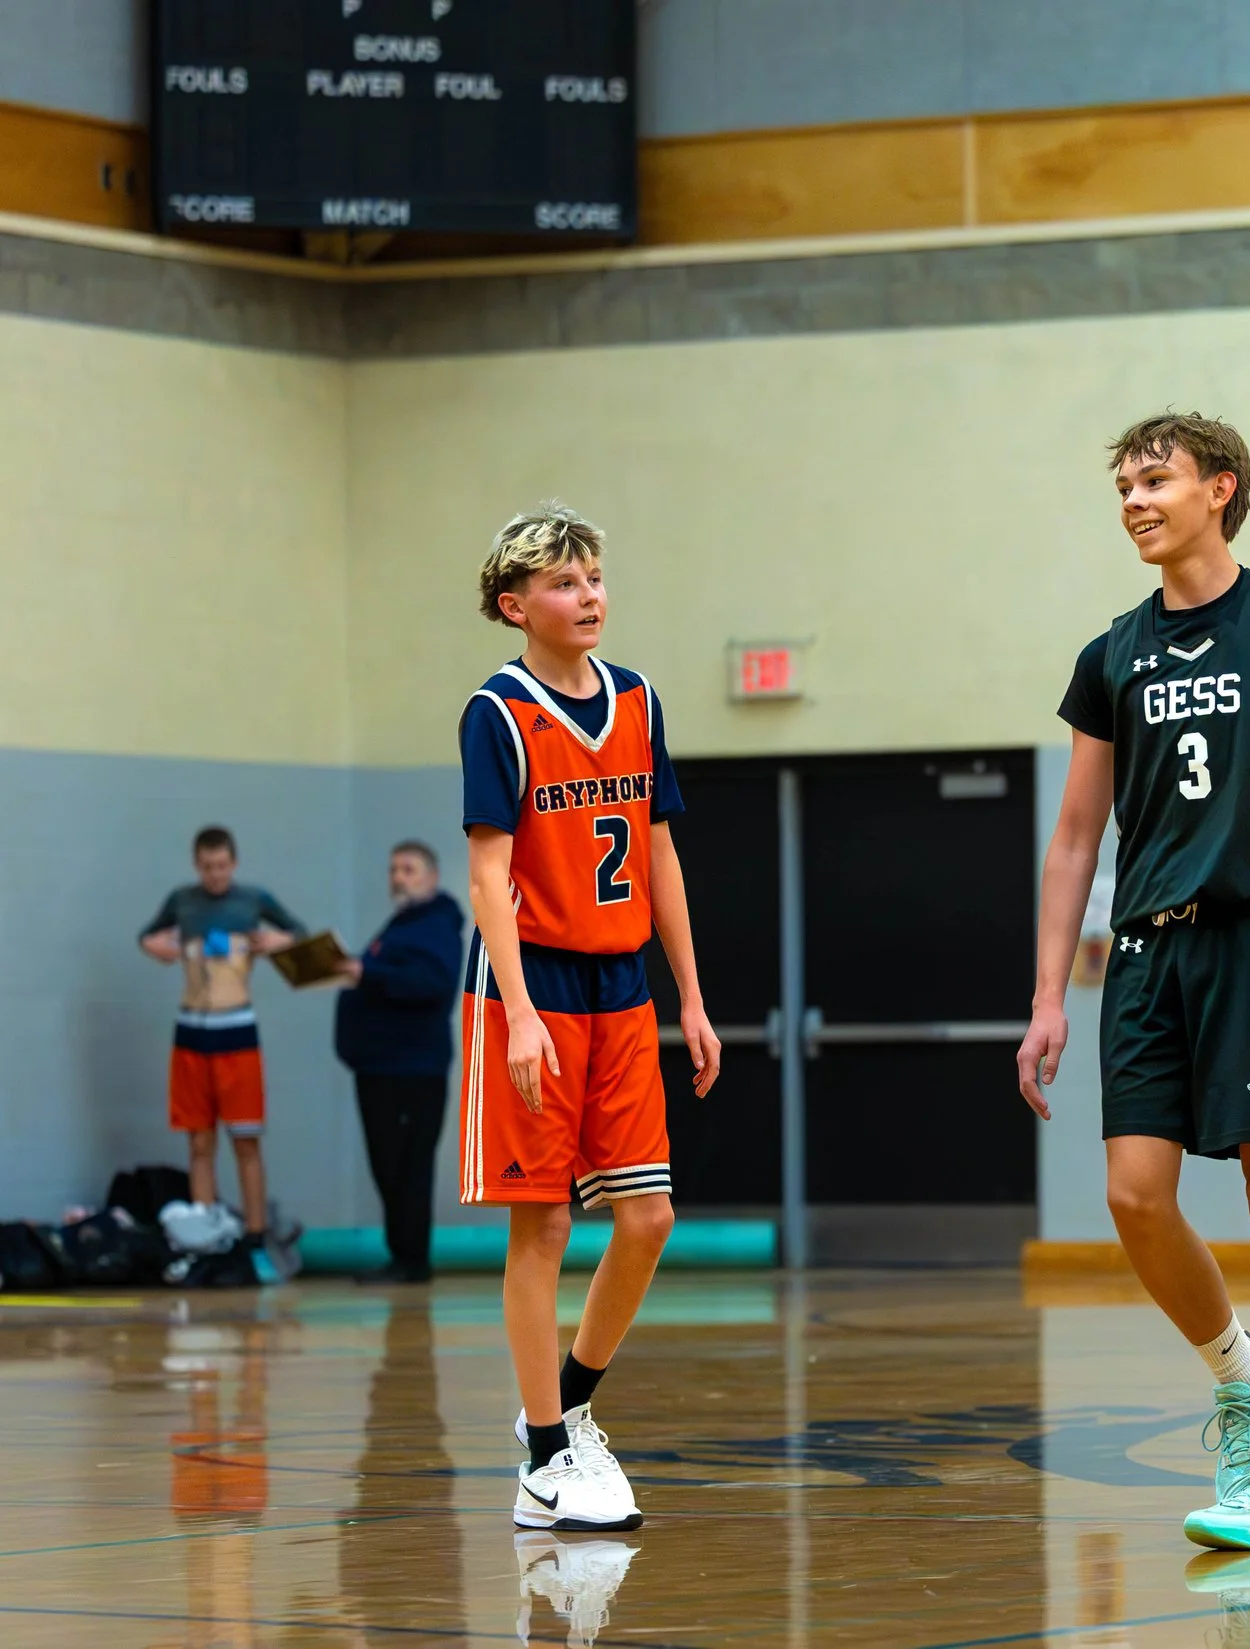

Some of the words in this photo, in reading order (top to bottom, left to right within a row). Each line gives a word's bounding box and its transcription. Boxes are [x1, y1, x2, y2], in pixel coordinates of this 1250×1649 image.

[354, 35, 441, 62] BONUS
[165, 66, 248, 94] FOULS
[306, 70, 404, 98] PLAYER
[435, 73, 502, 100] FOUL
[545, 75, 627, 103] FOULS
[321, 197, 410, 225] MATCH
[535, 202, 621, 229] SCORE
[1144, 673, 1241, 724] GESS
[1177, 732, 1212, 800] 3
[594, 815, 632, 906] 2
